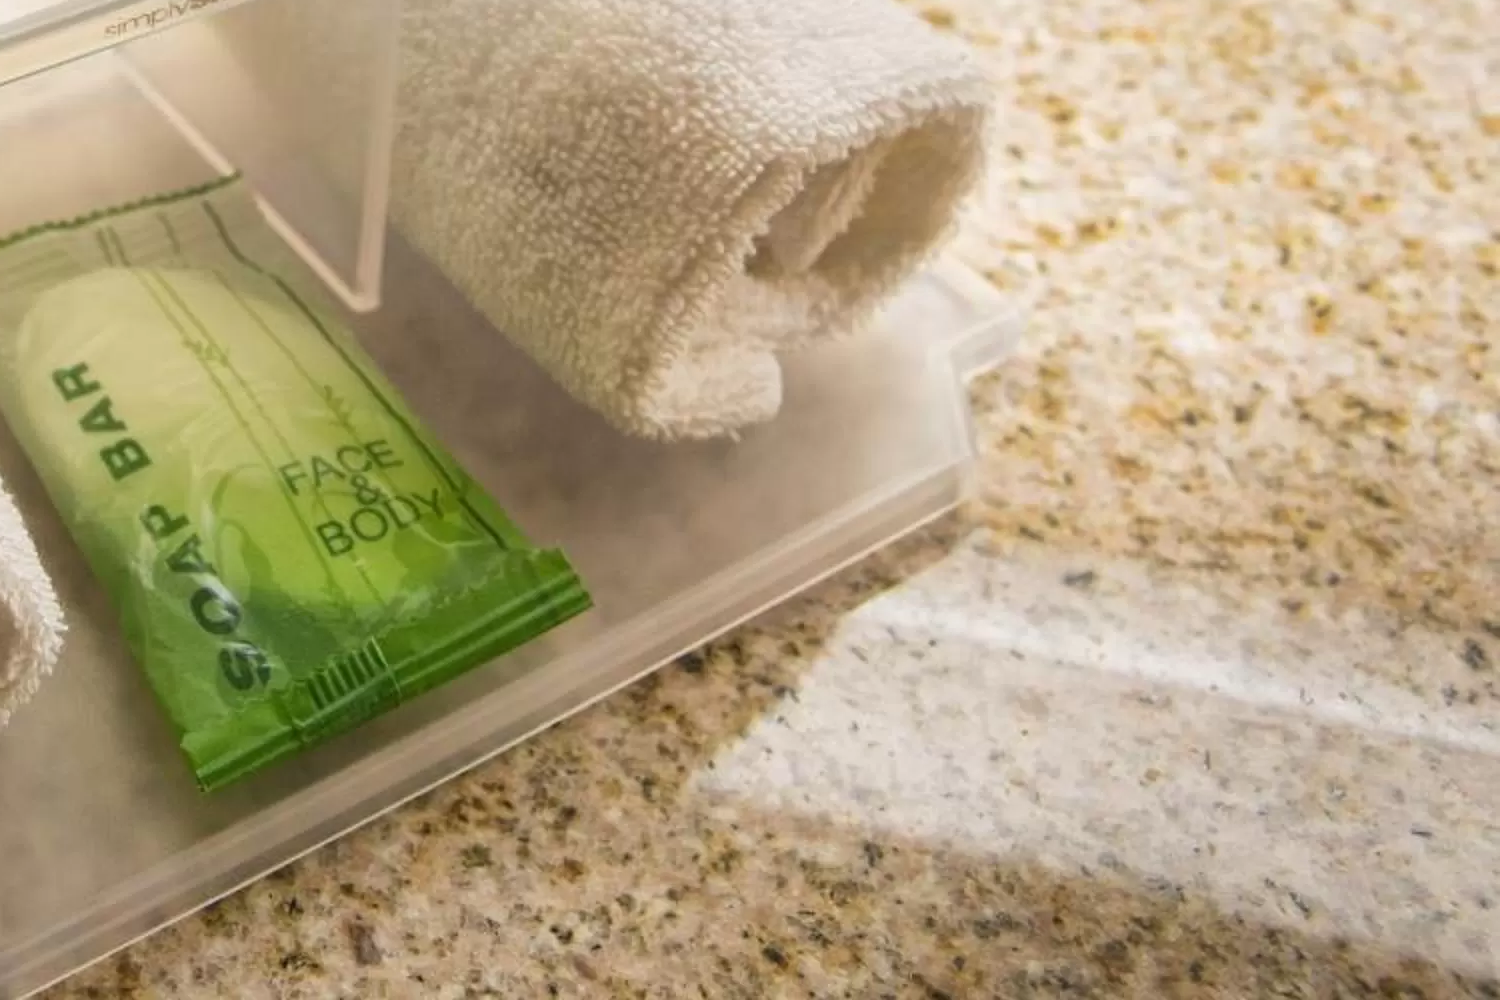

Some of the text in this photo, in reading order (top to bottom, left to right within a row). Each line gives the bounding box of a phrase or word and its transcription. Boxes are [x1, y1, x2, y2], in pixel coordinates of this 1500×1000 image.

[279, 439, 405, 497] FACE
[351, 474, 388, 506] &
[52, 361, 272, 692] SOAP BAR
[316, 487, 445, 557] BODY
